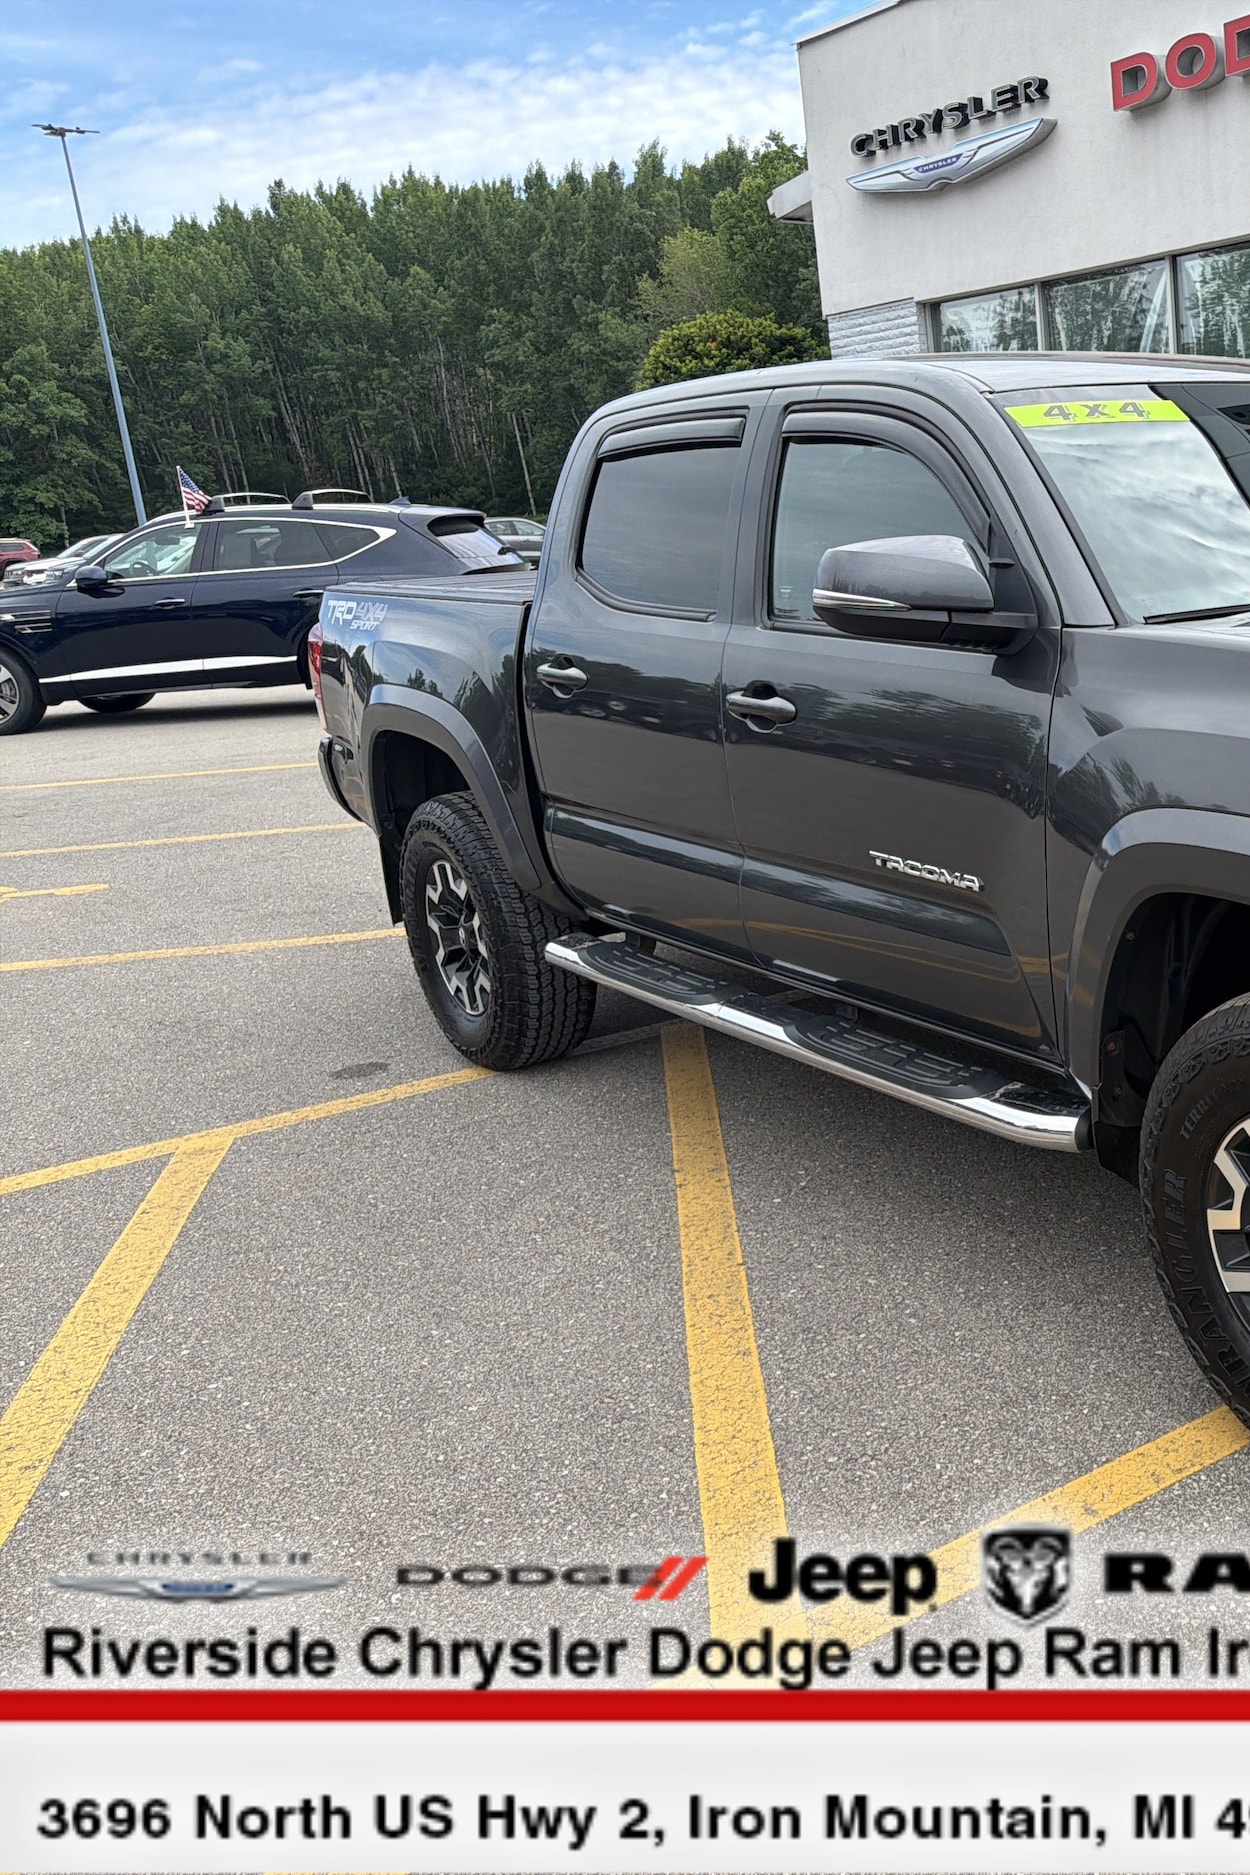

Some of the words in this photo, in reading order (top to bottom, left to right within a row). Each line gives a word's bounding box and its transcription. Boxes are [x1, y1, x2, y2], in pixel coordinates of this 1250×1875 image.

[850, 75, 1049, 158] CHRYSLER
[917, 157, 959, 173] CHRYSLER
[327, 600, 357, 625] TRD
[350, 621, 380, 631] SPORT
[868, 850, 985, 893] TACOMA
